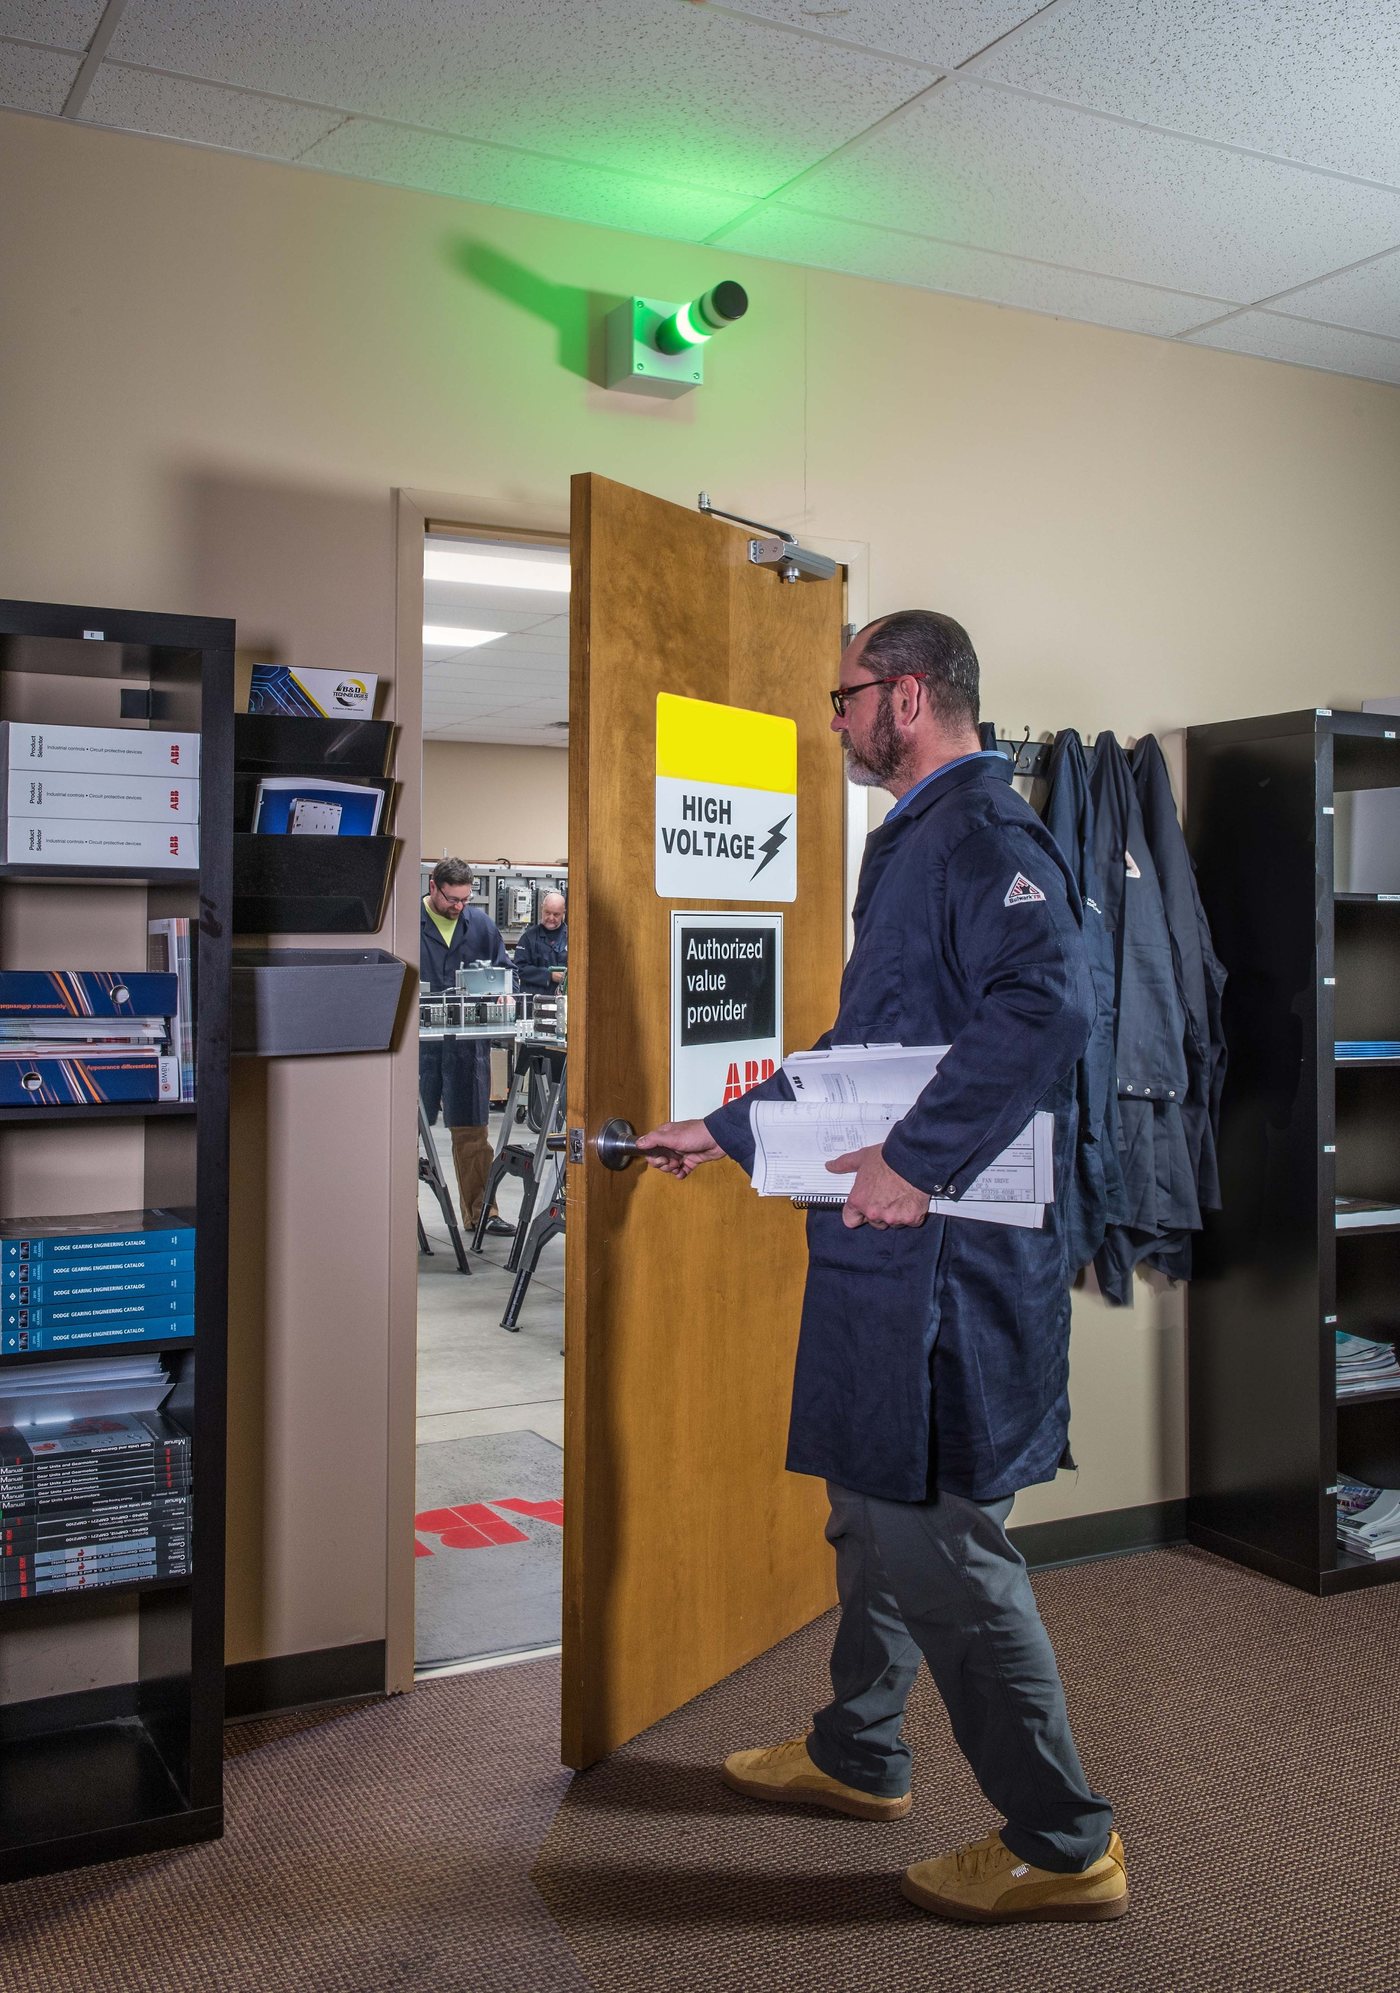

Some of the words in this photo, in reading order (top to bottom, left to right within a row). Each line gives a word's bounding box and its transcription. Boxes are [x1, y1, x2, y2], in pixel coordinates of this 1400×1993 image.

[170, 745, 179, 765] ABB
[170, 791, 178, 810] ABB
[682, 794, 731, 825] HIGH
[170, 836, 178, 855] ABB
[662, 827, 754, 860] VOLTAGE
[686, 938, 763, 960] Authorized
[687, 970, 726, 991] value
[687, 999, 747, 1028] provider
[792, 1076, 805, 1090] ABB
